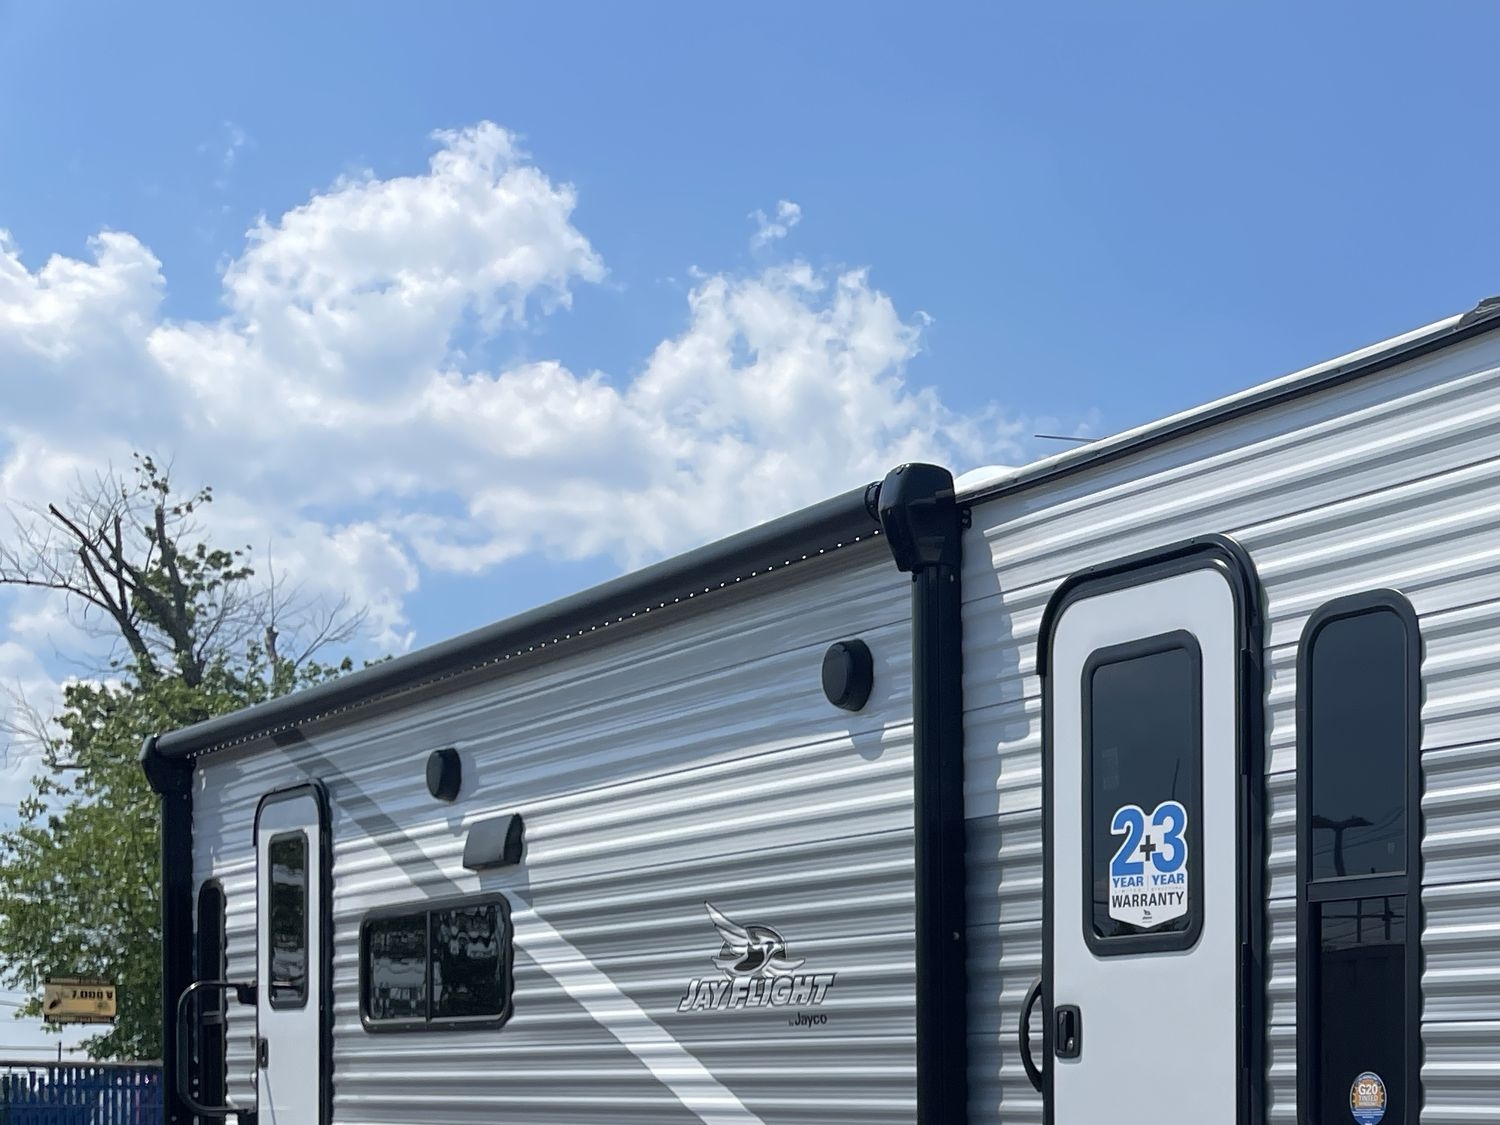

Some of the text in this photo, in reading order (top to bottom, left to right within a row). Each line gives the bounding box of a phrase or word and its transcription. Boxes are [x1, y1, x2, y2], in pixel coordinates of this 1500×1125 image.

[1112, 873, 1185, 888] YEAR YEAR
[1111, 891, 1185, 908] WARRANTY
[677, 972, 837, 1012] JAY FLIGHT
[794, 1011, 828, 1028] Jayco
[1358, 1084, 1378, 1095] G20
